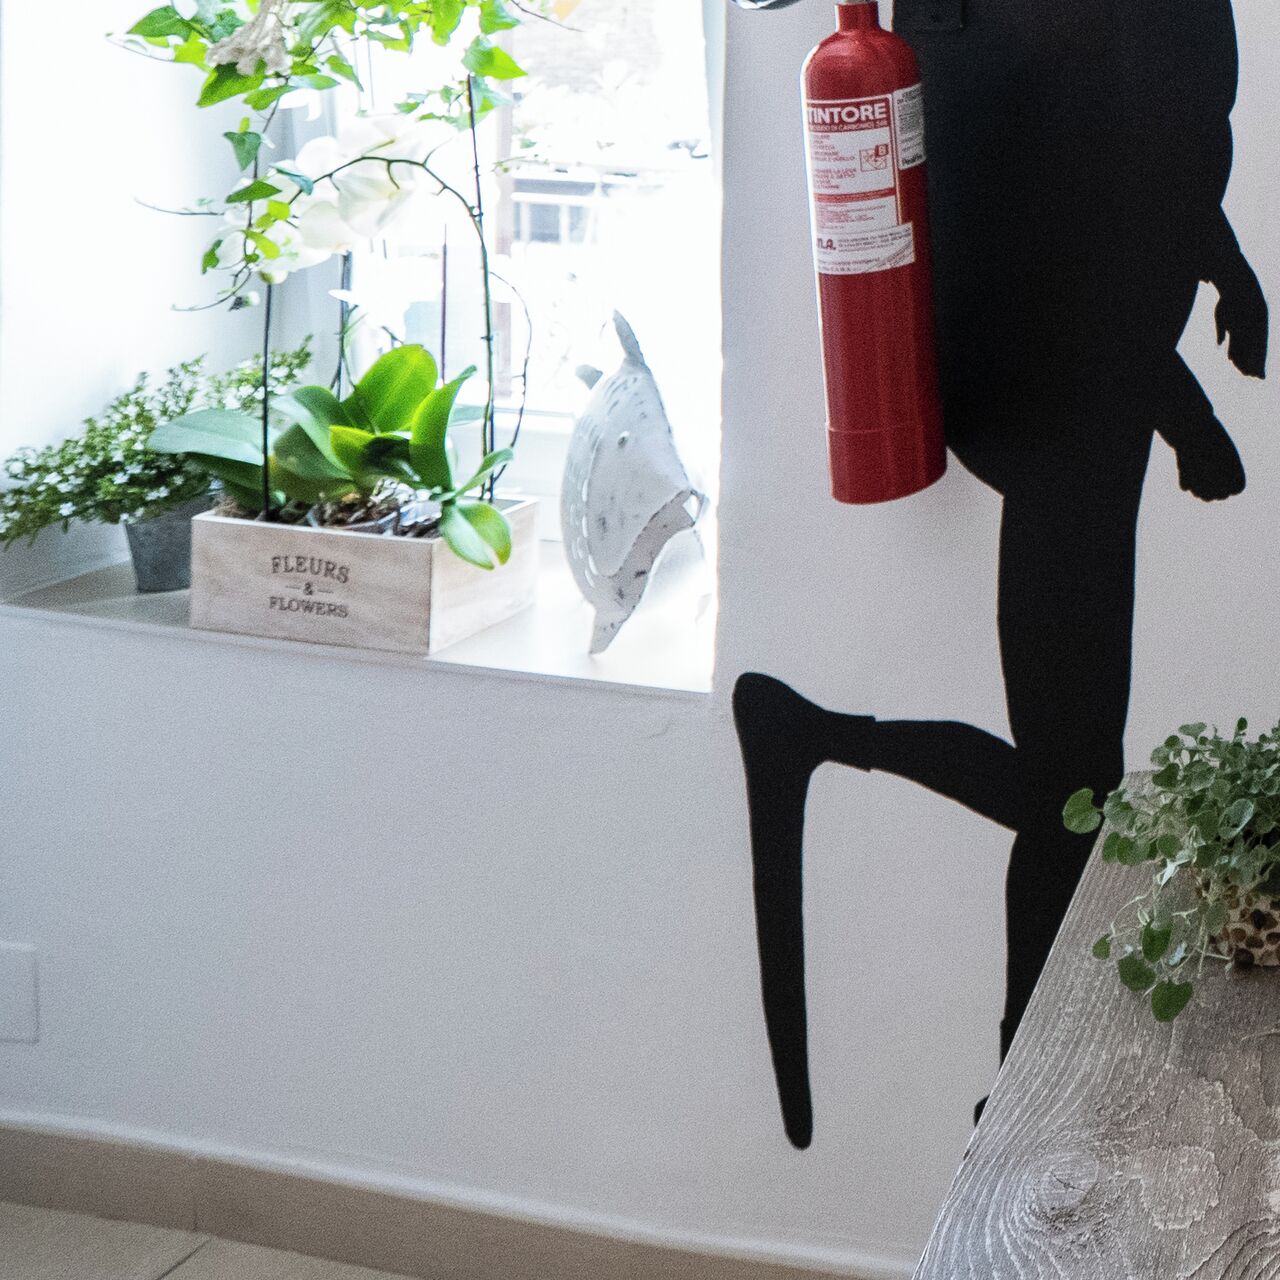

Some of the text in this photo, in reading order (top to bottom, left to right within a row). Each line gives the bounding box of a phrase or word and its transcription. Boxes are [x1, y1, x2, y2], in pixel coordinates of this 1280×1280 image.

[272, 555, 350, 583] FLEURS
[303, 581, 313, 595] &
[268, 596, 348, 618] FLOWERS
